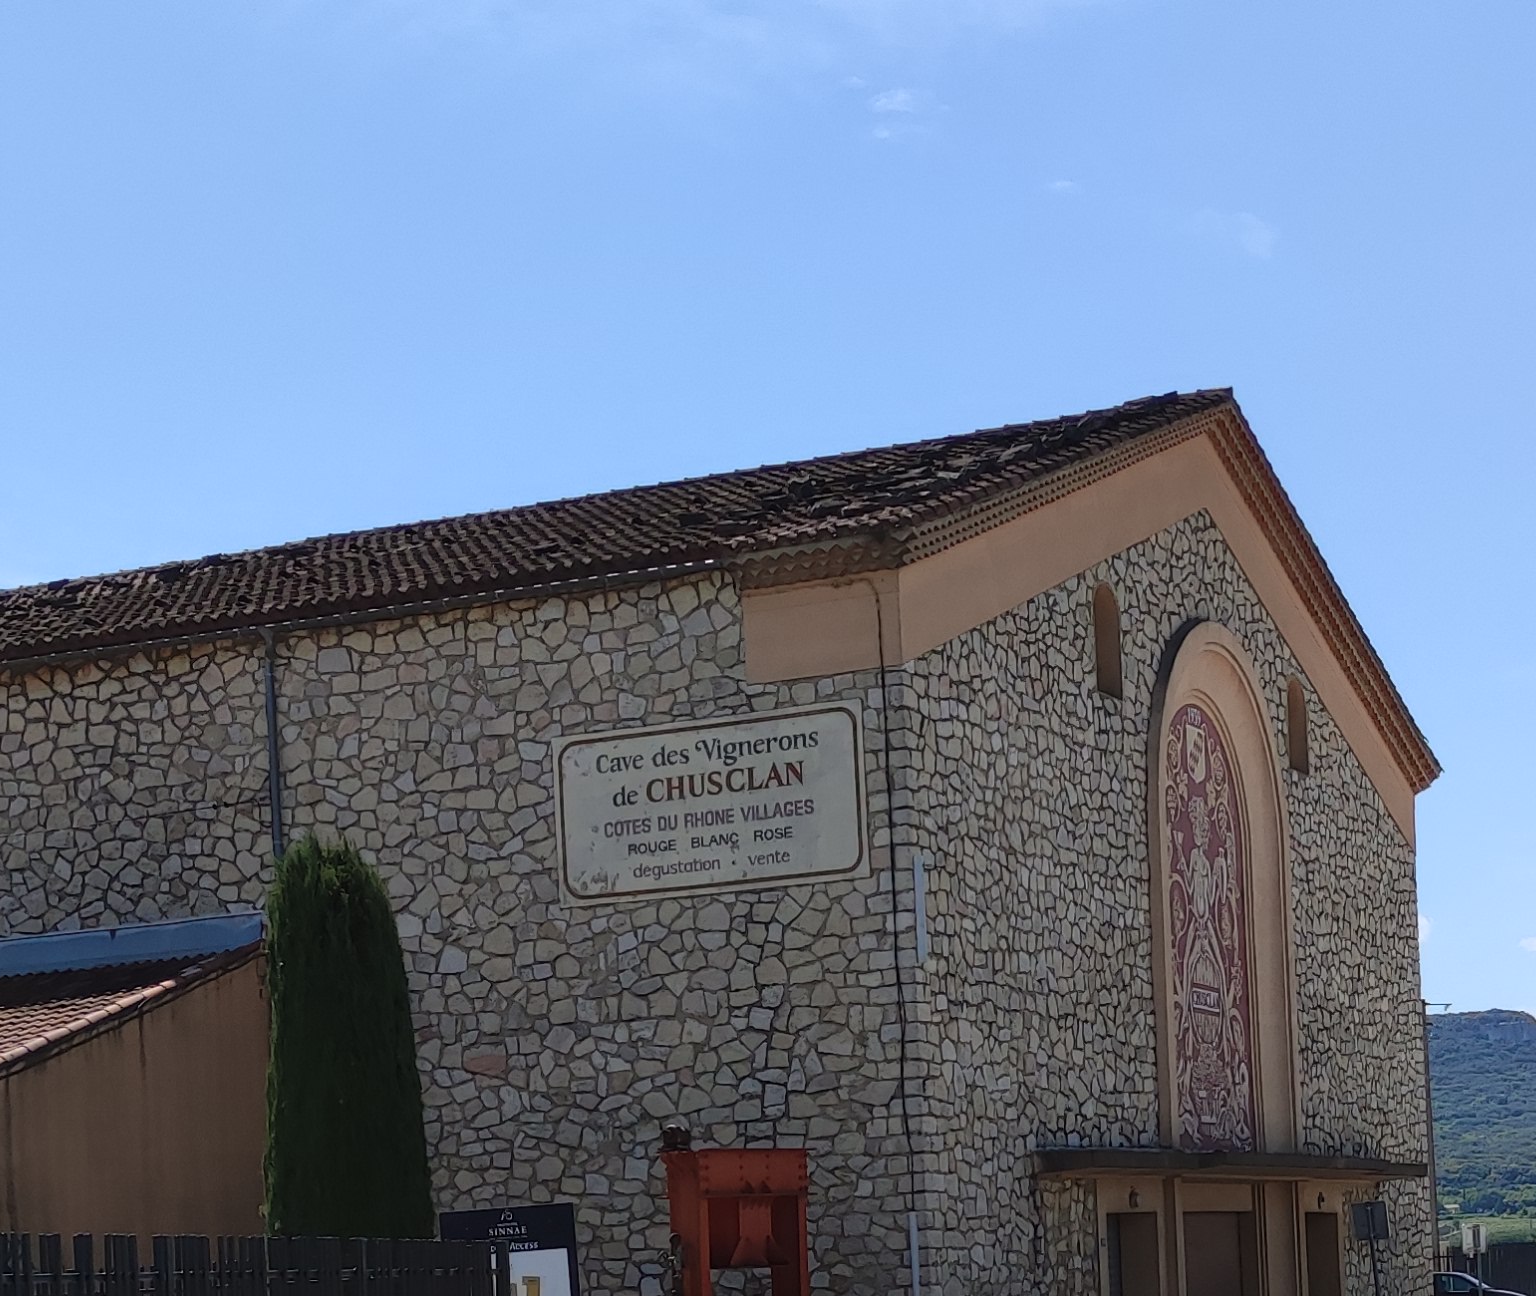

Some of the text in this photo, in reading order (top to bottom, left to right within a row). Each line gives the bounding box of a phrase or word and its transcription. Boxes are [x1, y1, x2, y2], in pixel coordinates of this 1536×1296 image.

[596, 731, 818, 774] Cave des Vignerons
[612, 760, 804, 807] de CHUSCLAN
[657, 814, 678, 832] DU
[740, 799, 814, 822] VILLAGES
[628, 839, 677, 856] ROUGE
[690, 832, 739, 849] BLANC
[747, 850, 791, 866] vente
[488, 1225, 528, 1236] SINNAE
